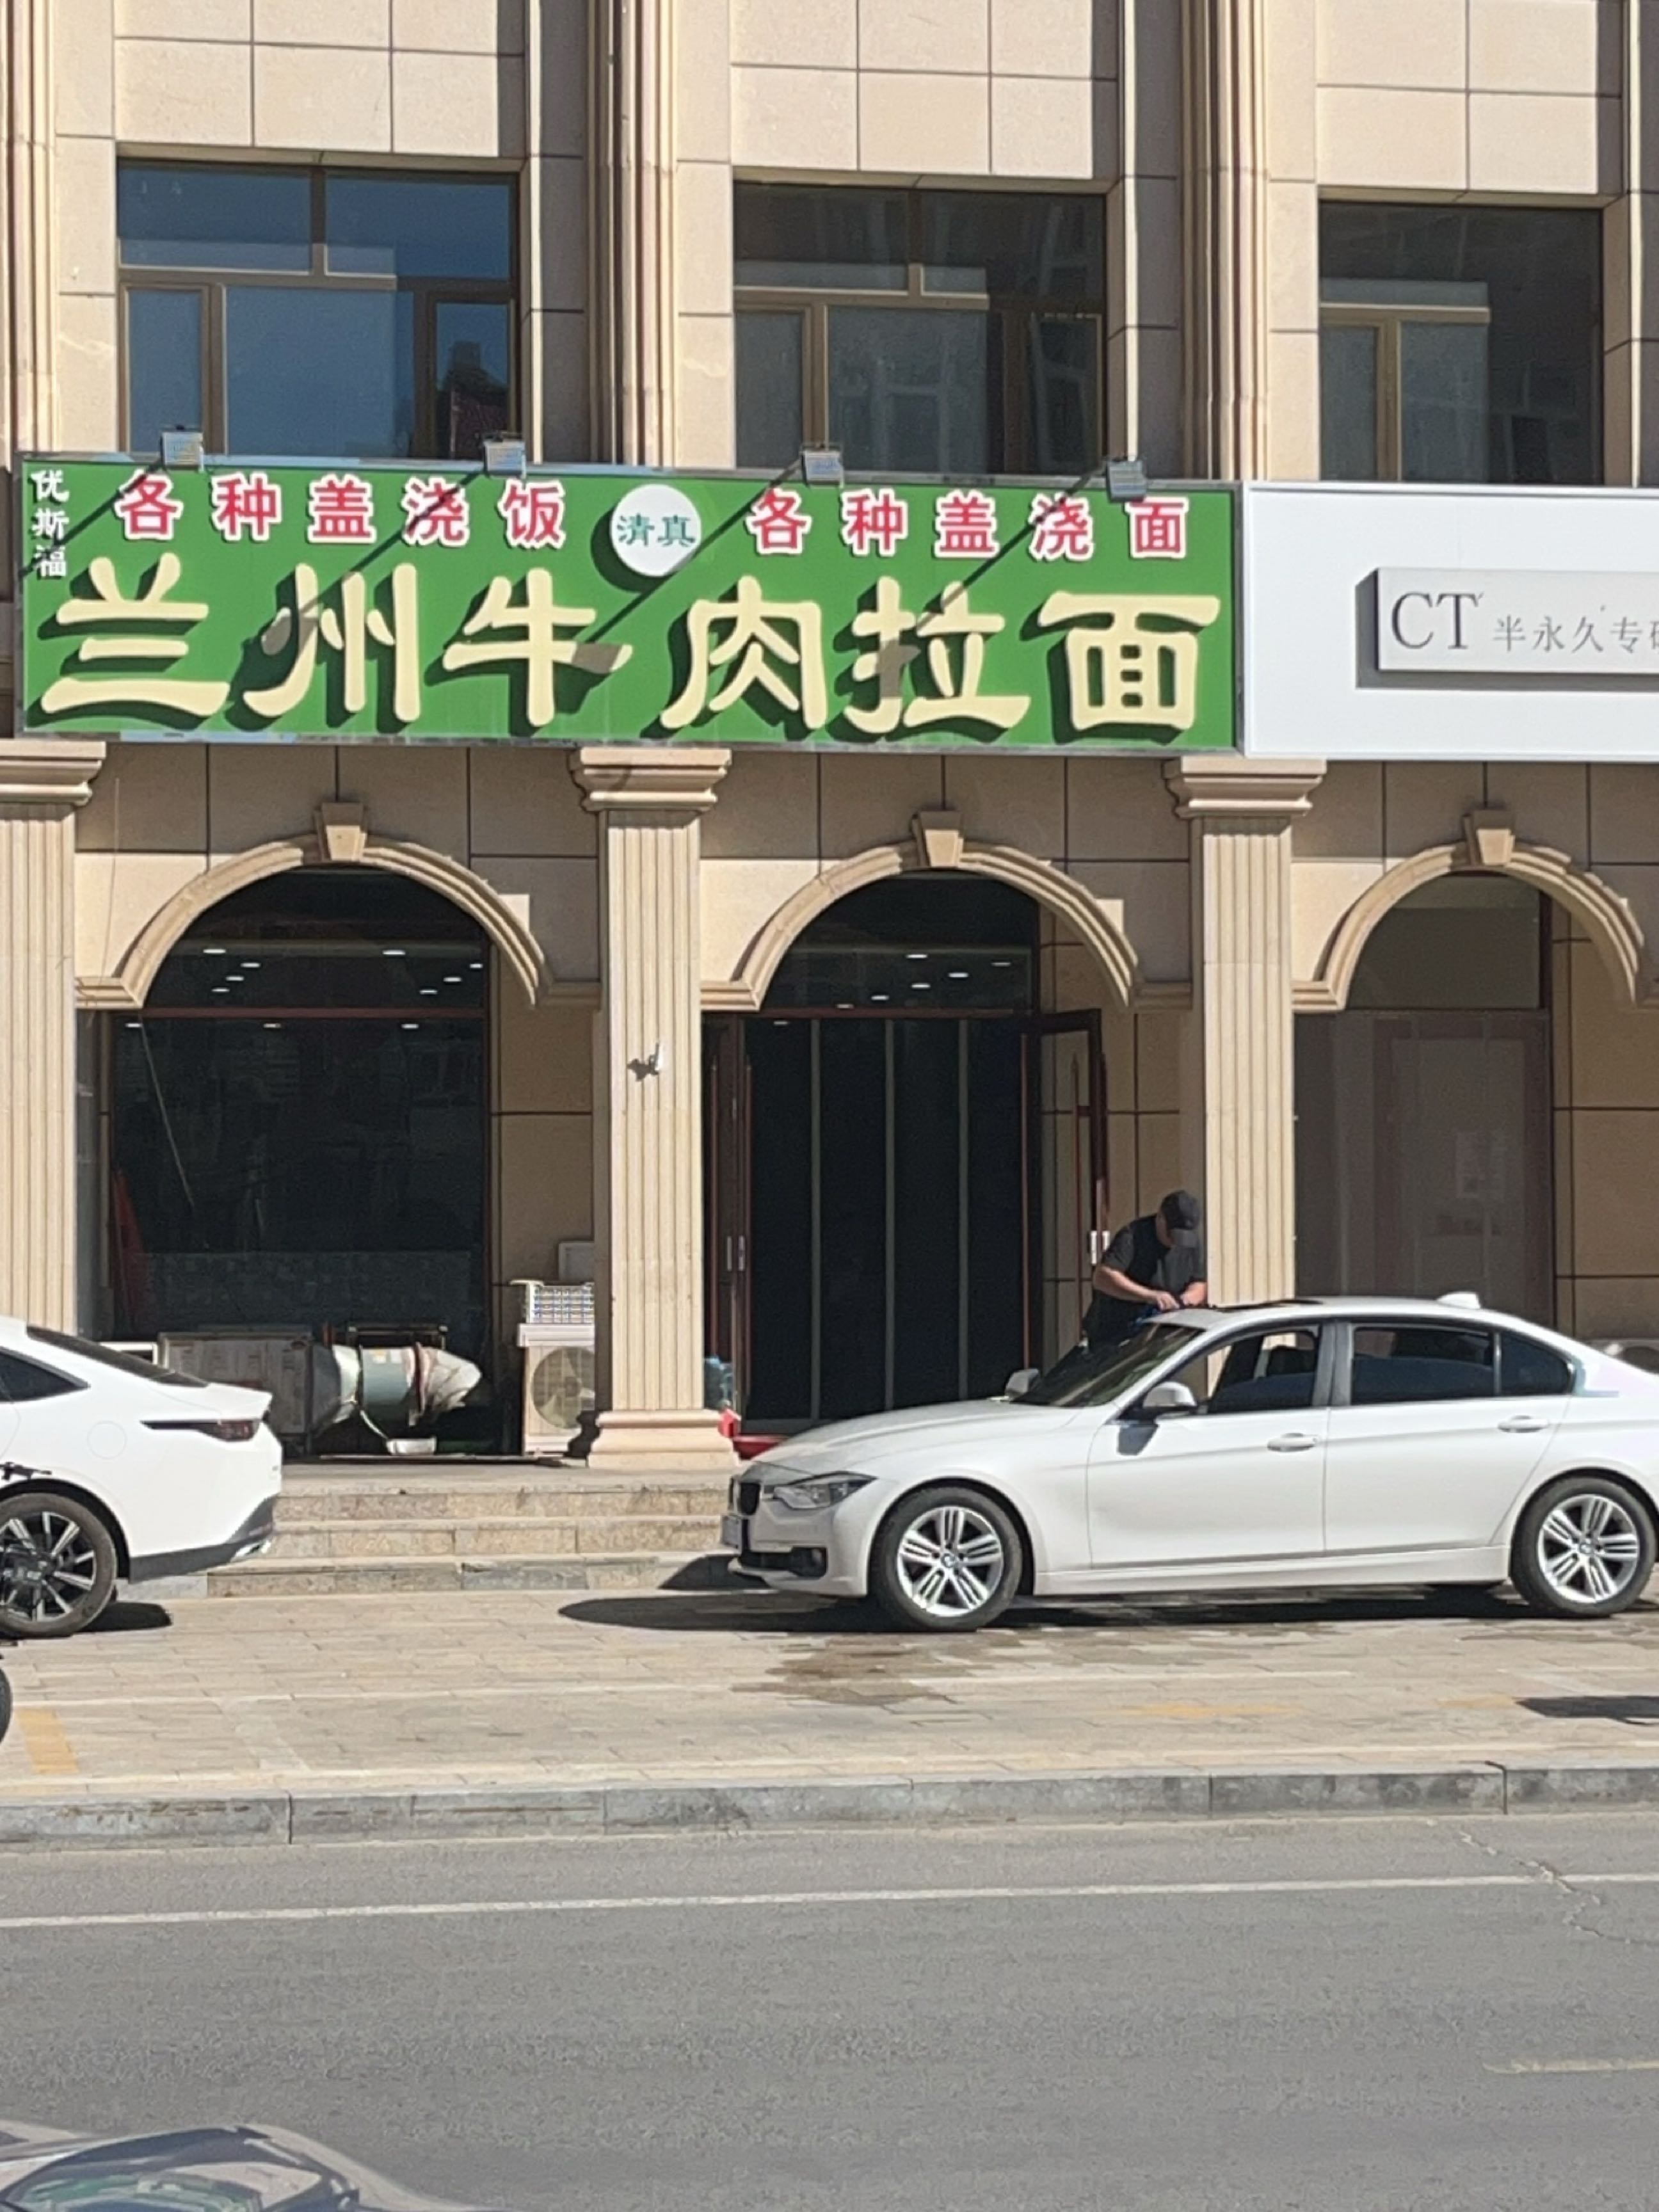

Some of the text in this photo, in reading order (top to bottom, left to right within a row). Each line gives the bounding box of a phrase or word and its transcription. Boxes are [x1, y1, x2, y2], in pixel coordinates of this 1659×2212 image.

[30, 469, 70, 577] 优斯福
[114, 469, 566, 550] 各种盖浇饭
[616, 513, 696, 548] 清真
[746, 486, 1189, 561] 各种盖浇面
[41, 552, 1221, 734] 兰州牛肉拉面
